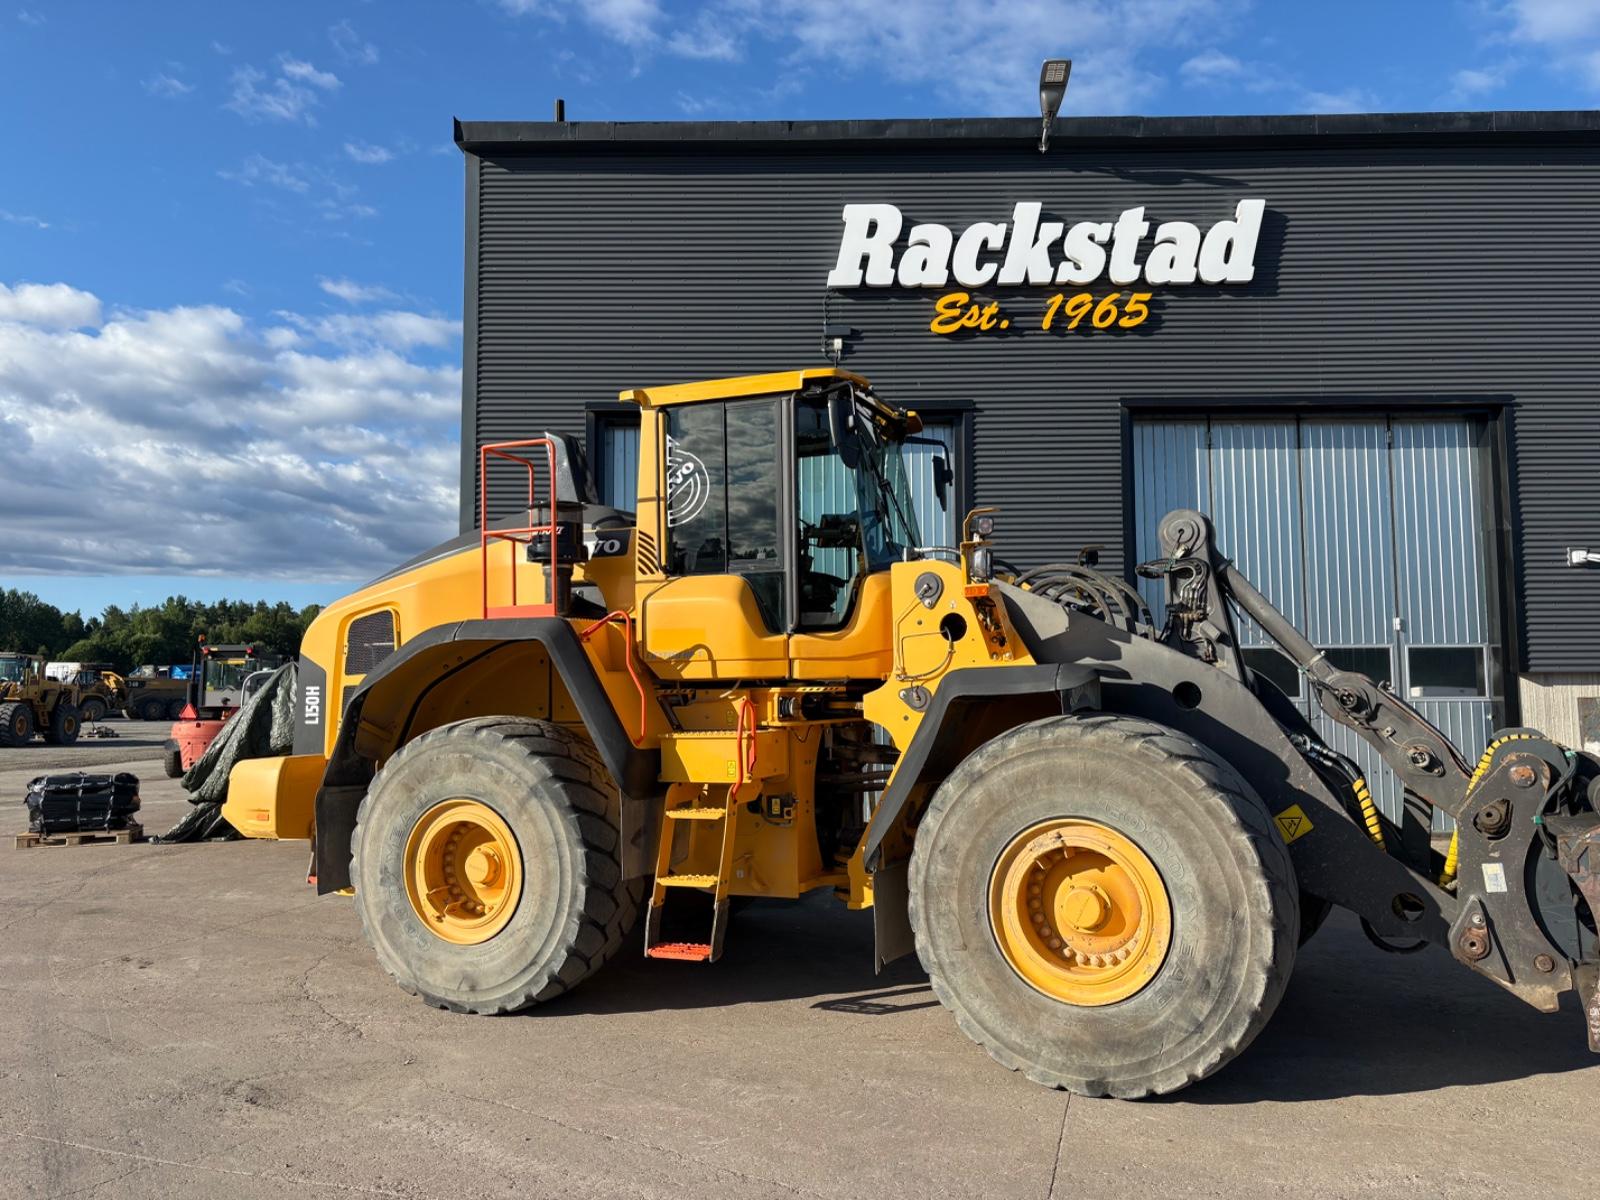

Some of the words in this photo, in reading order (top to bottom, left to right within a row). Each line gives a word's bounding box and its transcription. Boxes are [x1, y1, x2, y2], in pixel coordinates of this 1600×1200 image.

[827, 199, 1266, 288] Rackstad
[930, 292, 1010, 334] Est.
[1041, 292, 1153, 330] 1965
[304, 686, 320, 725] L150H
